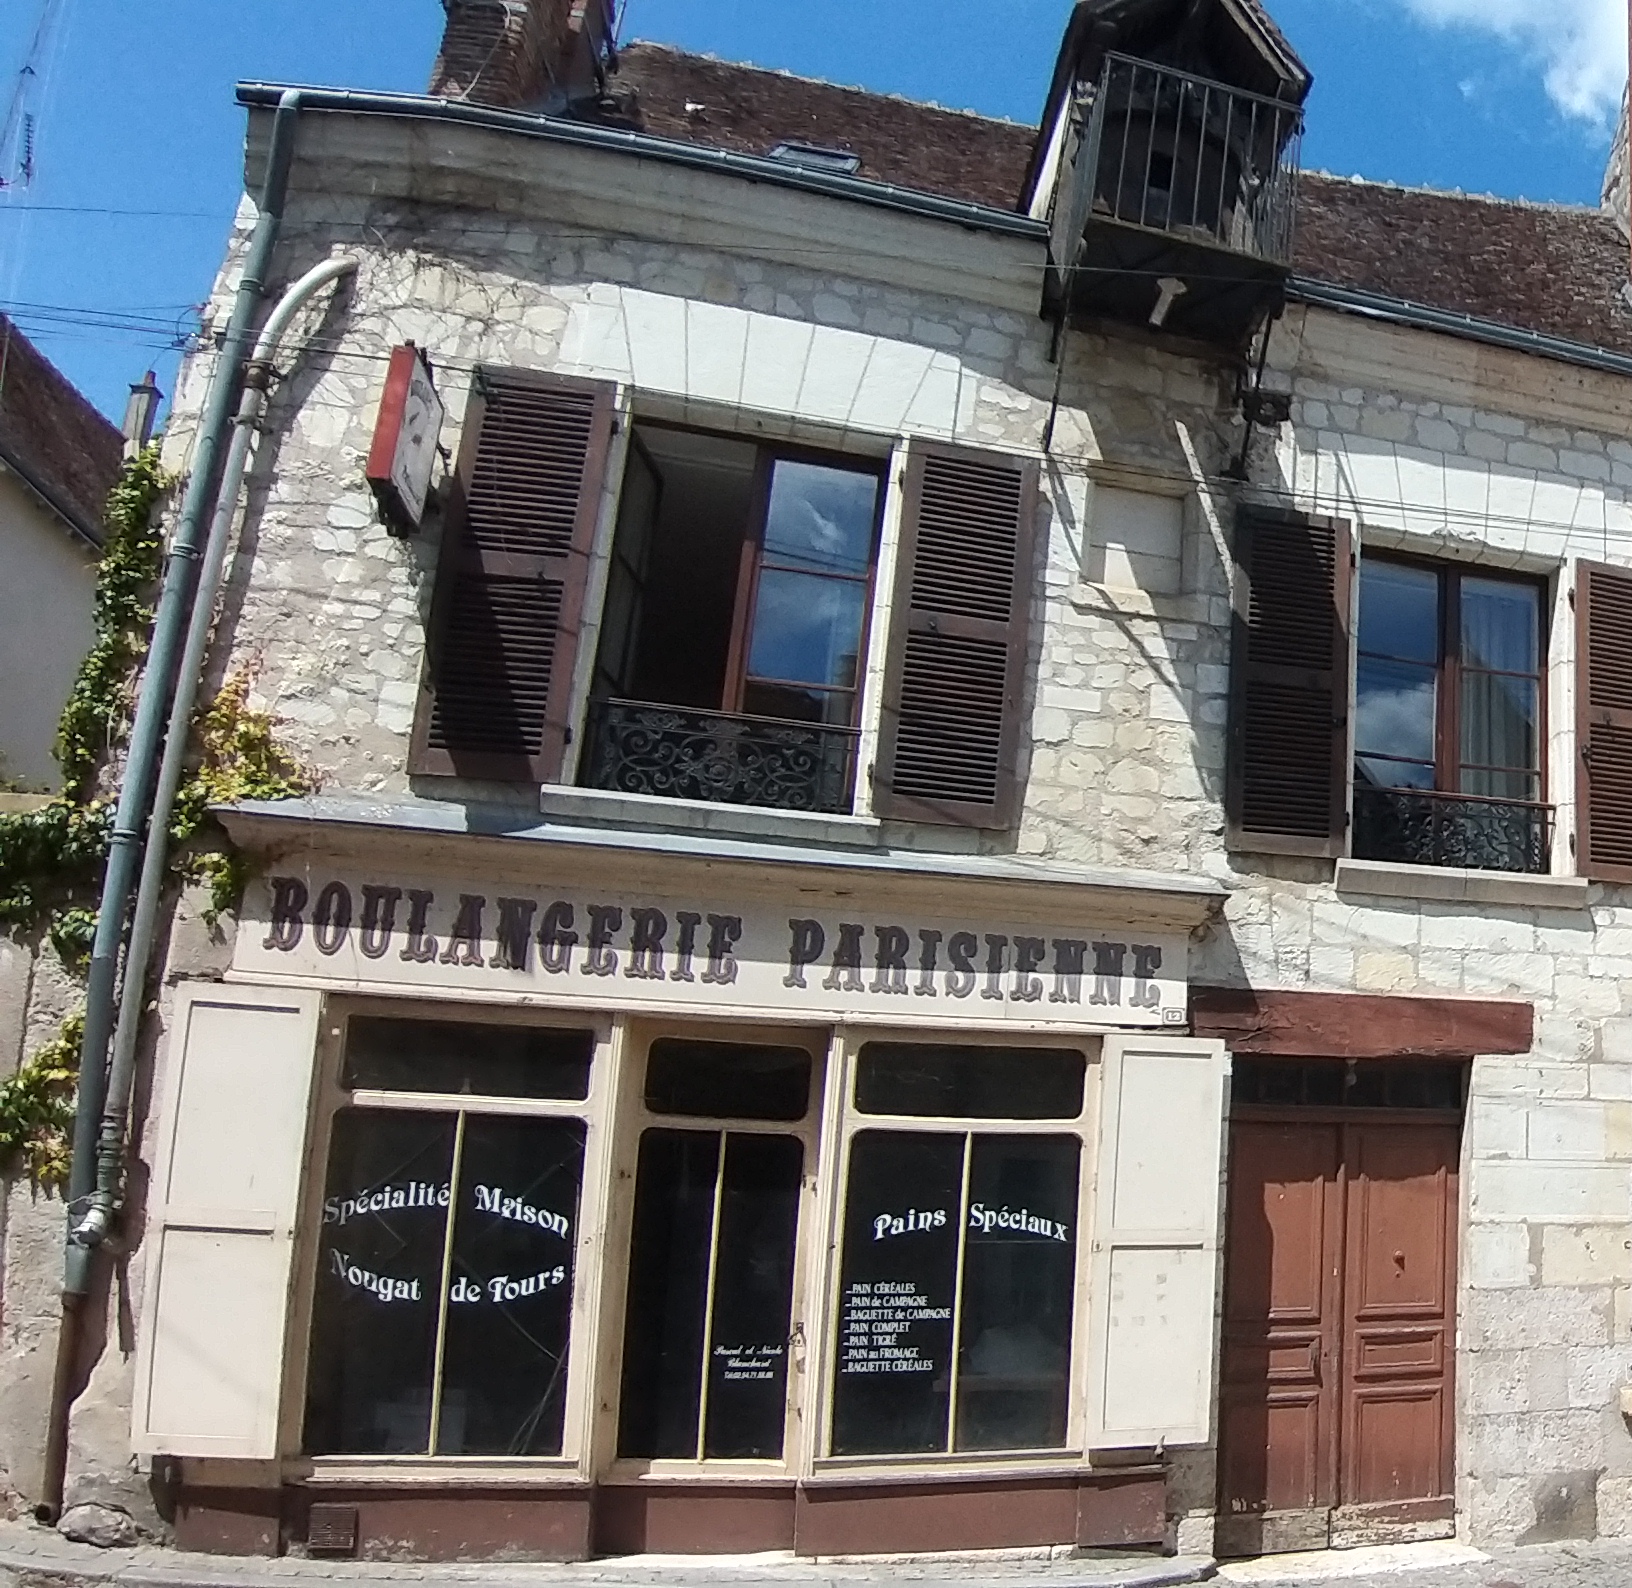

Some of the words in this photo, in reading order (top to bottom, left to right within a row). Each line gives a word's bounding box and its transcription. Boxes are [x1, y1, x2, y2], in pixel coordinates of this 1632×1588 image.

[262, 876, 743, 986] BOULANGERIE
[782, 918, 1161, 1009] PARISIENNE
[1167, 1011, 1182, 1021] 12
[323, 1181, 450, 1226] Spécialité
[475, 1184, 569, 1239] Maison
[874, 1208, 947, 1240] Pains
[969, 1203, 1069, 1242] Spéciaux
[329, 1248, 421, 1302] Nougat
[451, 1277, 481, 1302] de
[487, 1264, 565, 1302] Tours
[874, 1281, 916, 1294] CÉRÉALES
[871, 1296, 881, 1307] de
[883, 1296, 928, 1307] CAMPAGNE
[895, 1308, 905, 1319] de
[906, 1308, 951, 1319] CAMPAGNE
[872, 1322, 911, 1333] COMPLET
[872, 1333, 897, 1346] TIGRÉ
[880, 1347, 919, 1359] FROMAGE
[892, 1359, 934, 1371] CÉRÉALES
